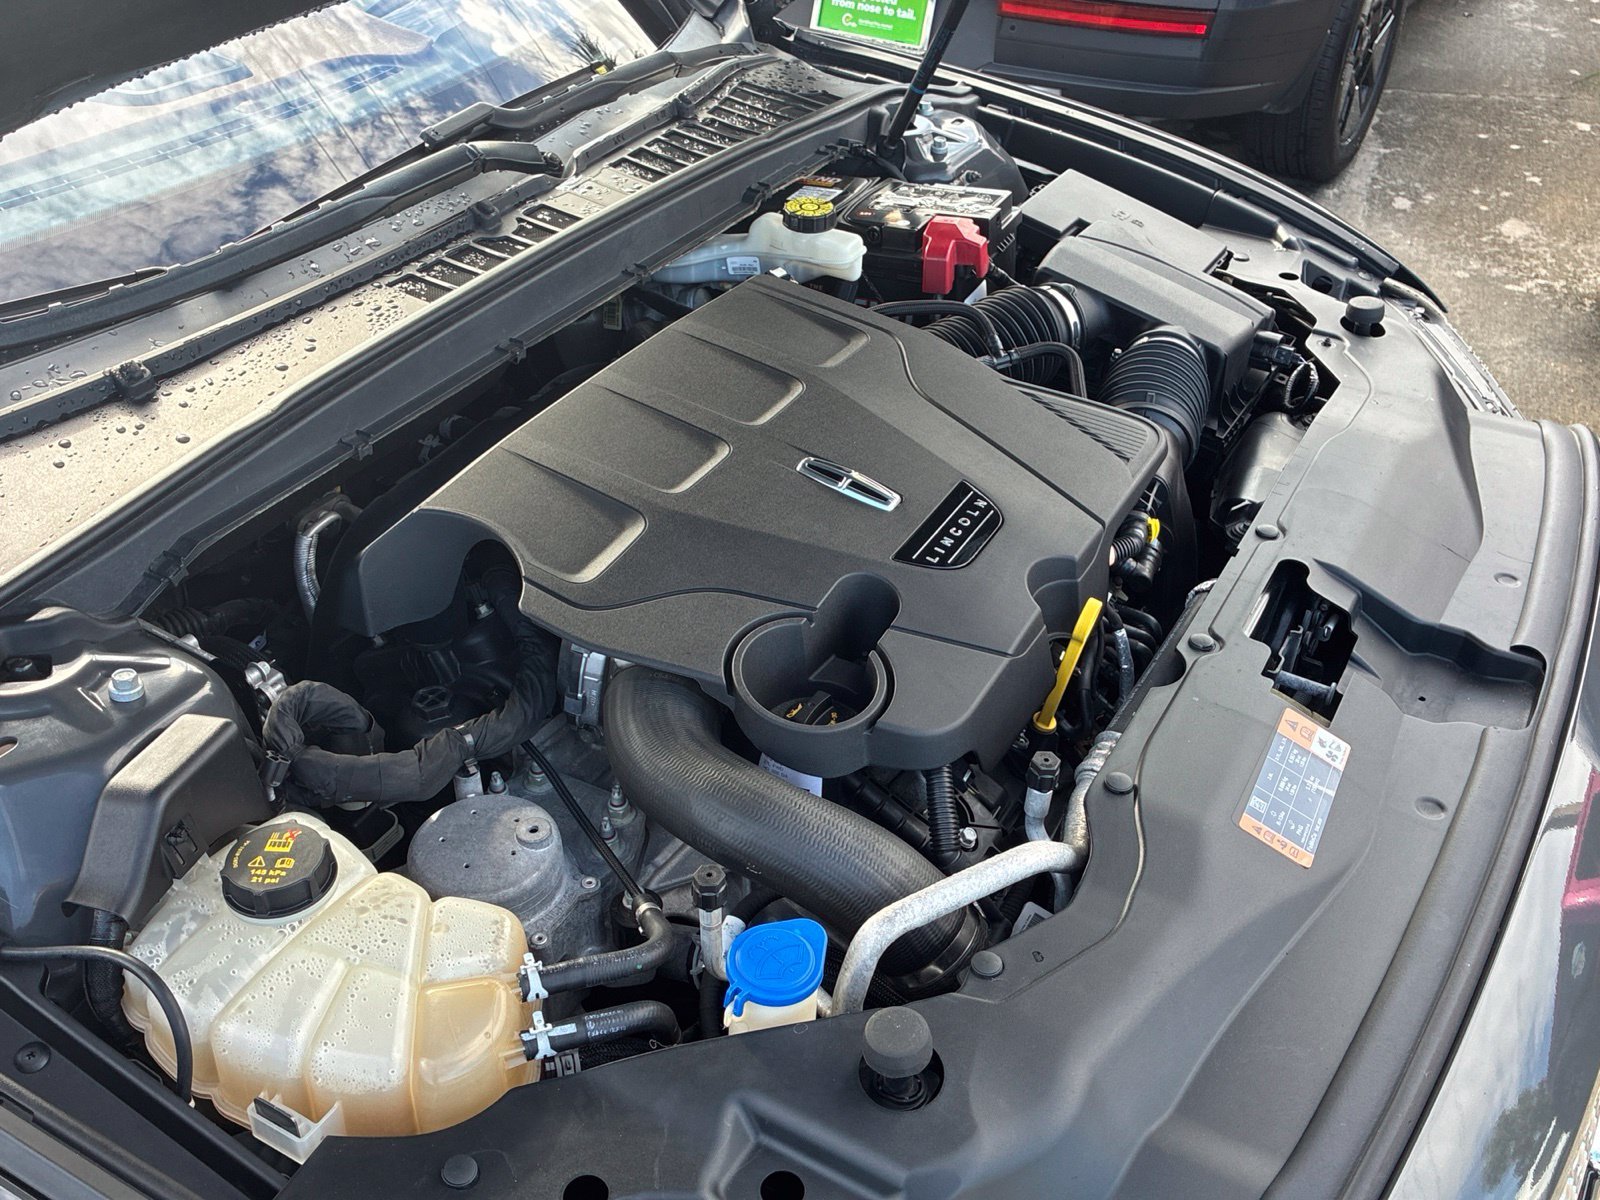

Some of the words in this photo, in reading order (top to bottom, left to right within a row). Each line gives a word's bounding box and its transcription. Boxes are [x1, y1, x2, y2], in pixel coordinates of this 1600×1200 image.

[831, 0, 855, 9] from
[857, 2, 881, 14] nose
[883, 5, 895, 16] to
[896, 7, 916, 20] tail.
[925, 498, 988, 563] LINCOLN
